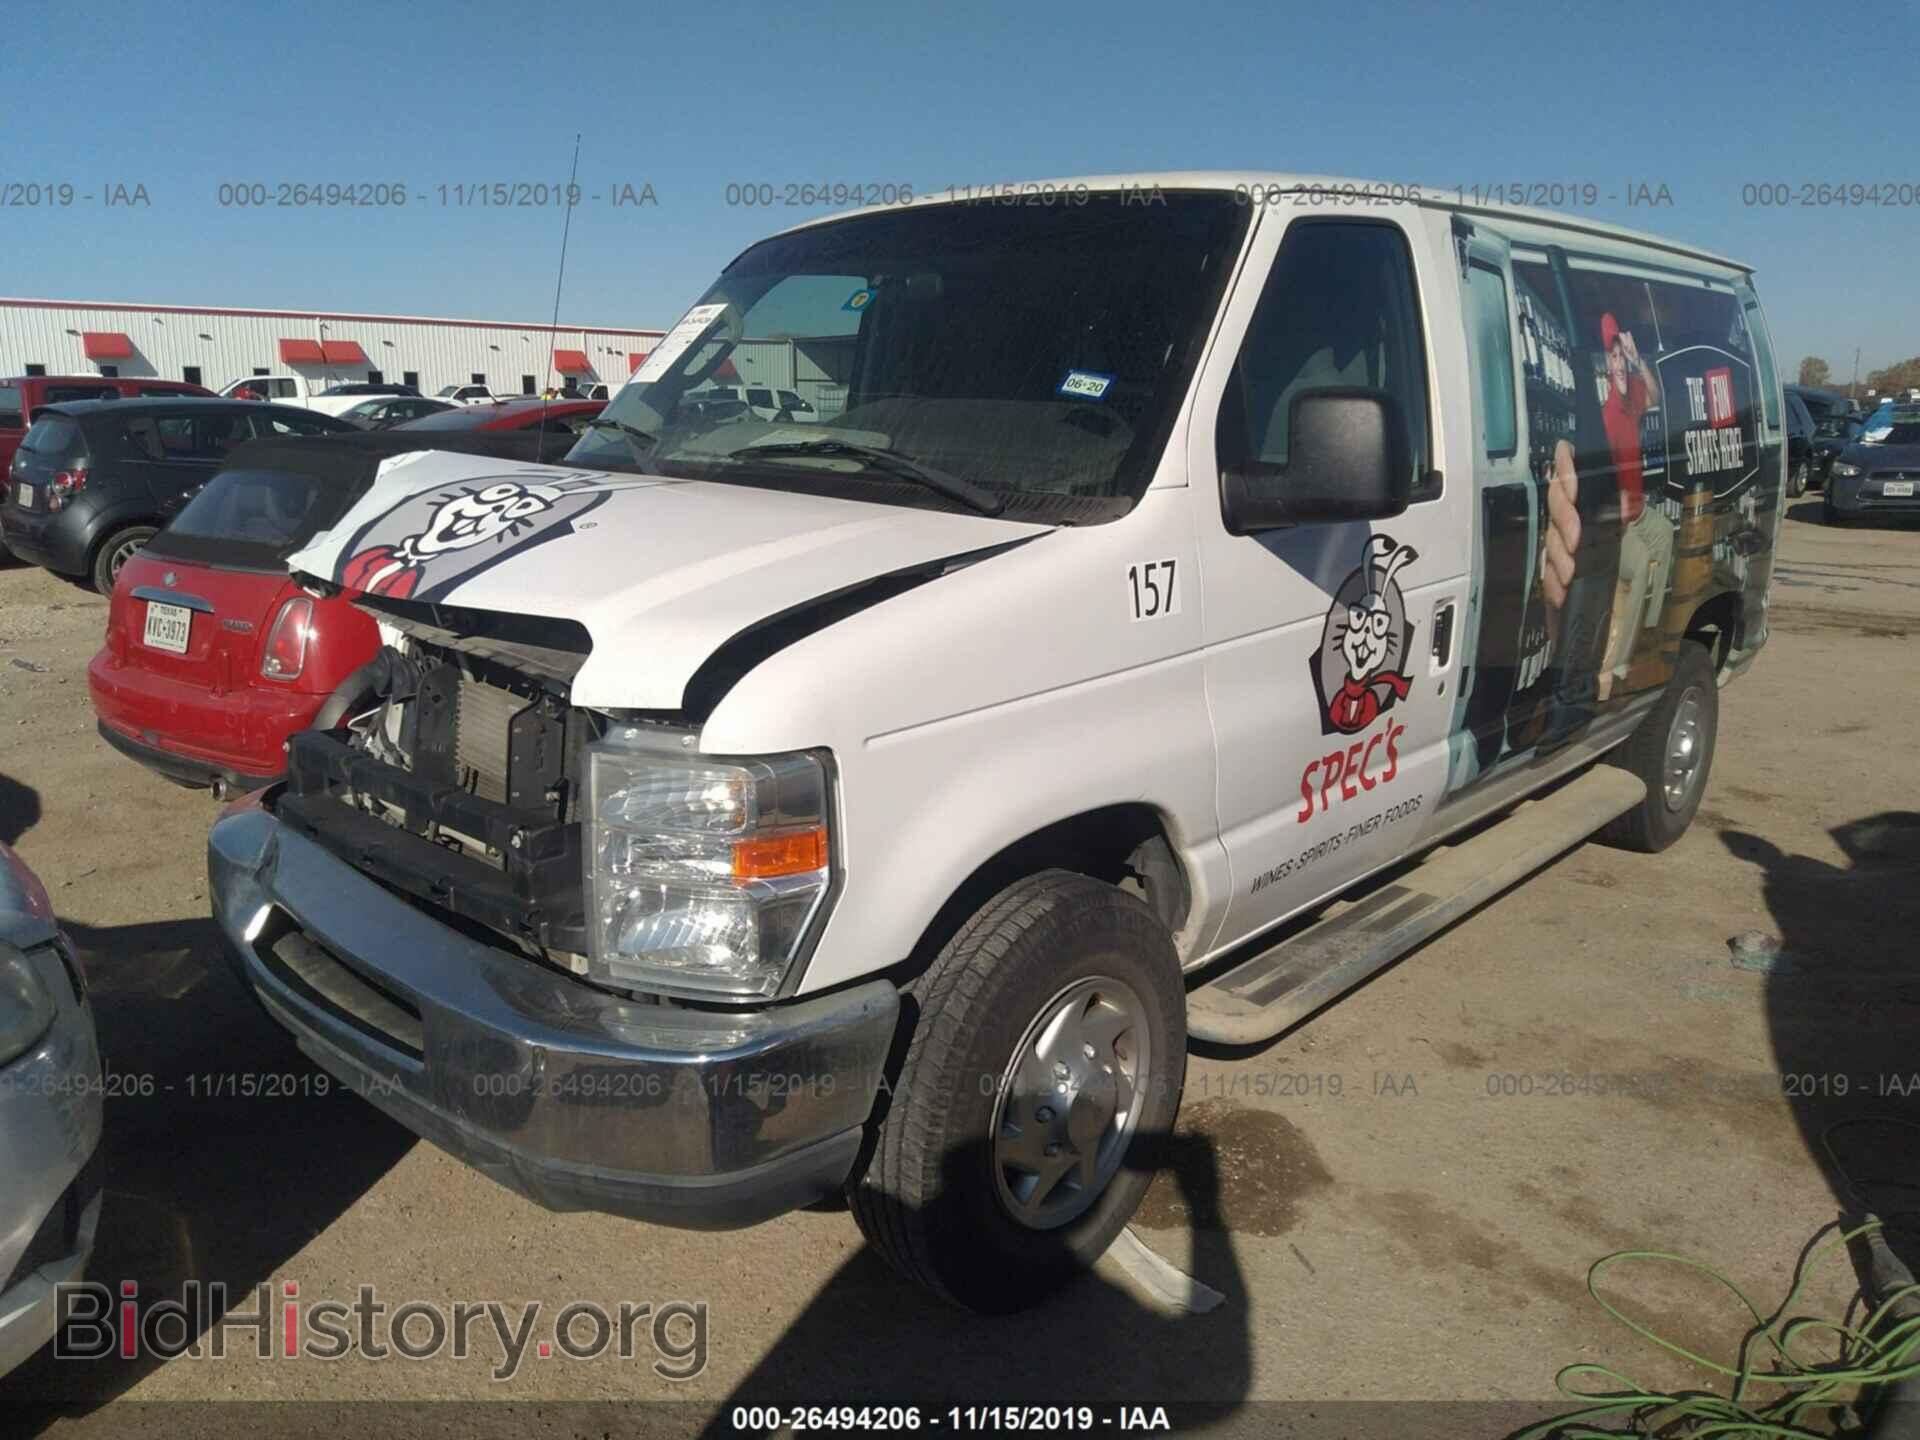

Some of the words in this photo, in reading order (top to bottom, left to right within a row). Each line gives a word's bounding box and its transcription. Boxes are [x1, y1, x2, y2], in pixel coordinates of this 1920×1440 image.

[1686, 377, 1708, 421] THE
[1711, 374, 1732, 422] FUN
[1685, 429, 1720, 475] STARTS
[1129, 560, 1176, 618] 157
[1297, 717, 1405, 823] SPEC'S
[1251, 859, 1294, 893] WINES
[1347, 814, 1381, 844] FINER
[1383, 794, 1423, 825] FOODS
